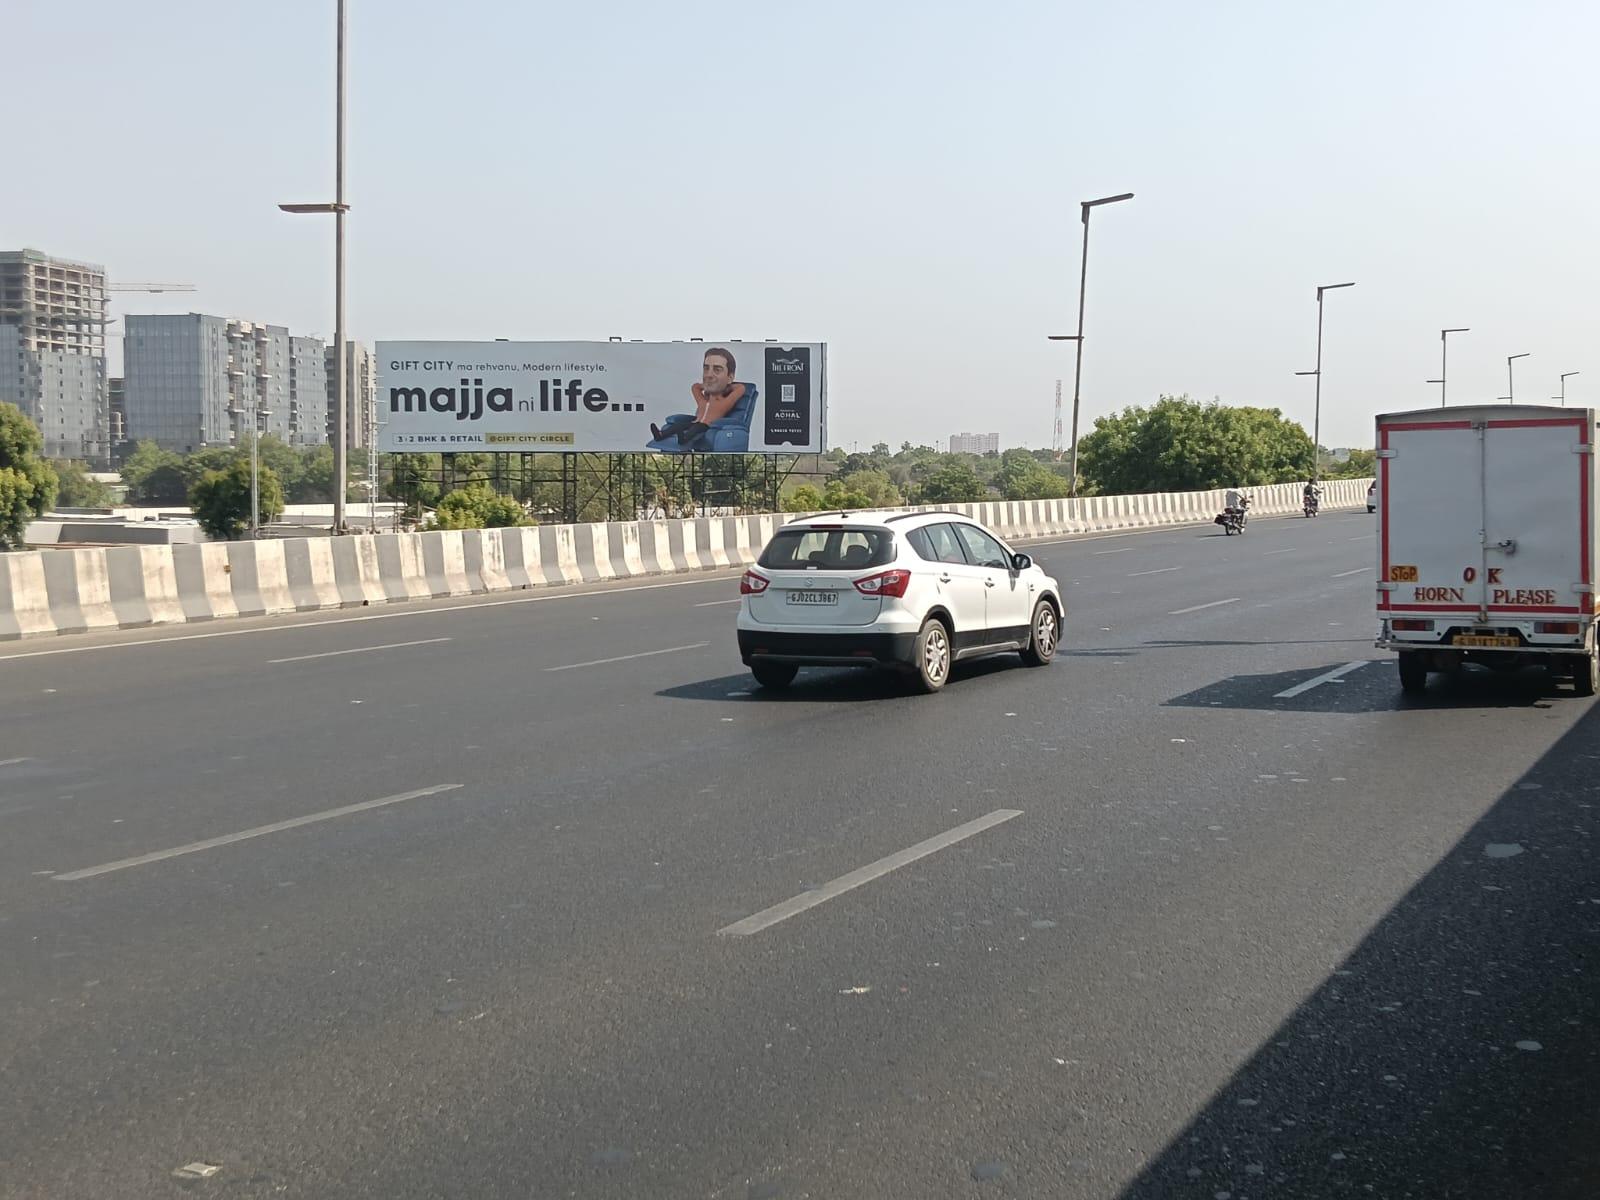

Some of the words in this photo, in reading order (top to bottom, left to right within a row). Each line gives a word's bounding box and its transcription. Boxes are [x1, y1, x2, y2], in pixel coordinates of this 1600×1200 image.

[390, 360, 420, 371] GIFT
[423, 360, 454, 371] CITY
[457, 363, 473, 371] ma
[475, 362, 520, 373] rehvanu,
[522, 363, 562, 372] Modern
[564, 363, 608, 373] lifestyle,
[389, 378, 514, 421] majja
[518, 396, 535, 412] ni
[417, 435, 438, 443] BHK
[449, 435, 483, 443] RETAIL
[1414, 587, 1464, 602] HORN
[1493, 589, 1556, 605] PLEASE
